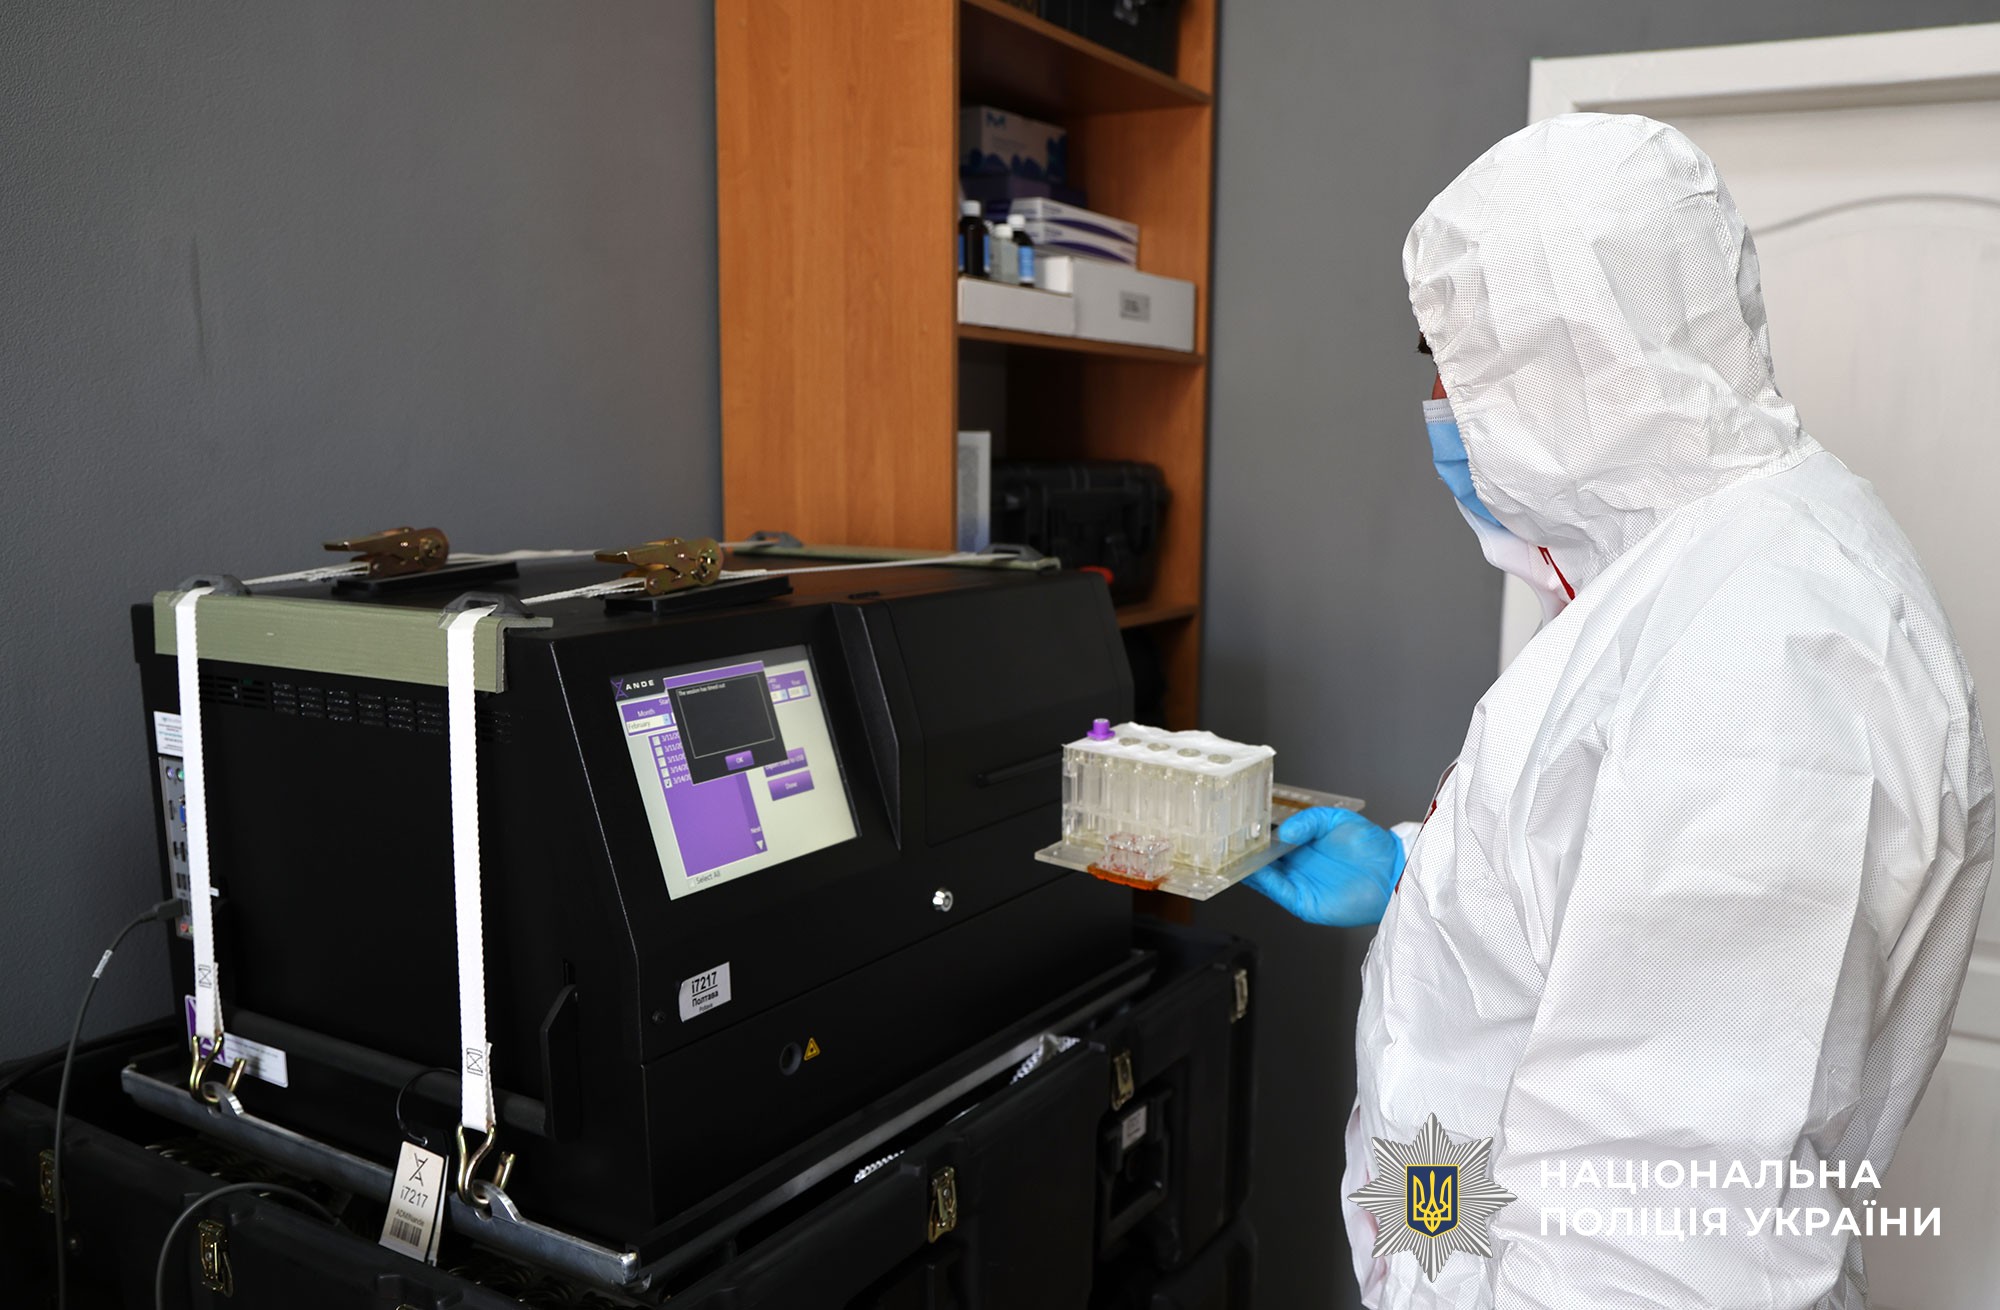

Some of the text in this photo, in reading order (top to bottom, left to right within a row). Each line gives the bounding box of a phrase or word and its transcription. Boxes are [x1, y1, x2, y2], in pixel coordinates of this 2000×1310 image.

[625, 679, 655, 690] ANDE
[637, 708, 656, 717] Month
[628, 721, 651, 729] February
[735, 756, 744, 764] OK
[695, 873, 713, 885] Select
[691, 971, 717, 994] i7217
[400, 1185, 429, 1208] i7217
